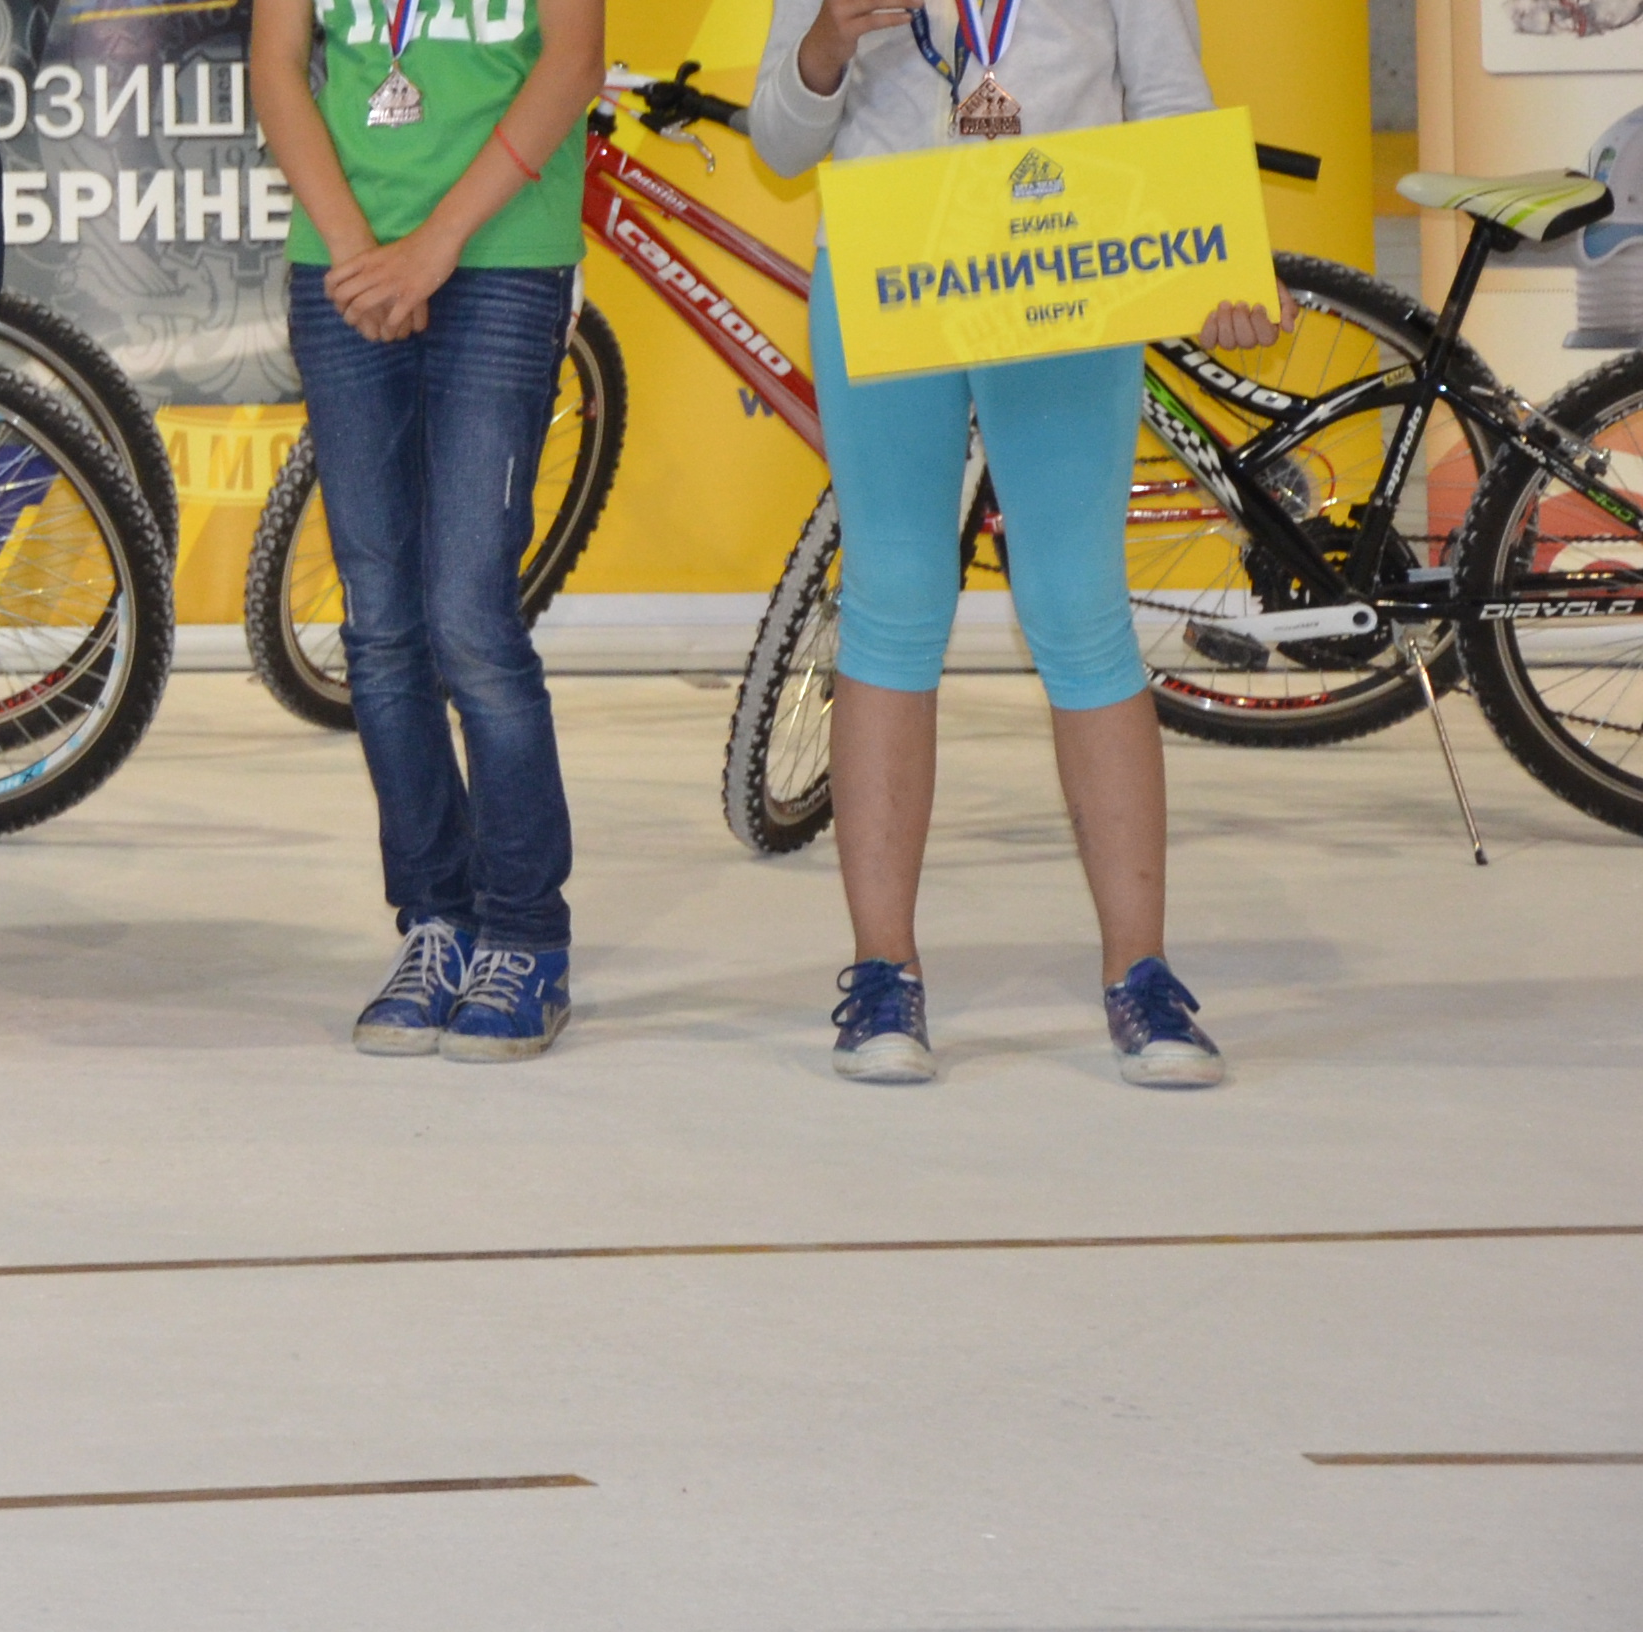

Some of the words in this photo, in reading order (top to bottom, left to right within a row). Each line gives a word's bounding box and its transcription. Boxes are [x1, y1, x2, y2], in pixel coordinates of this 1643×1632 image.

[2, 169, 292, 245] БРИНЕ
[1009, 210, 1078, 237] ЕКИПА
[616, 219, 792, 376] capriolo
[876, 224, 1228, 306] БРАНИЧЕВСКИ
[1026, 299, 1088, 325] ОКРУГ
[1161, 338, 1292, 411] riolo
[1480, 599, 1636, 620] DIAVOLO
